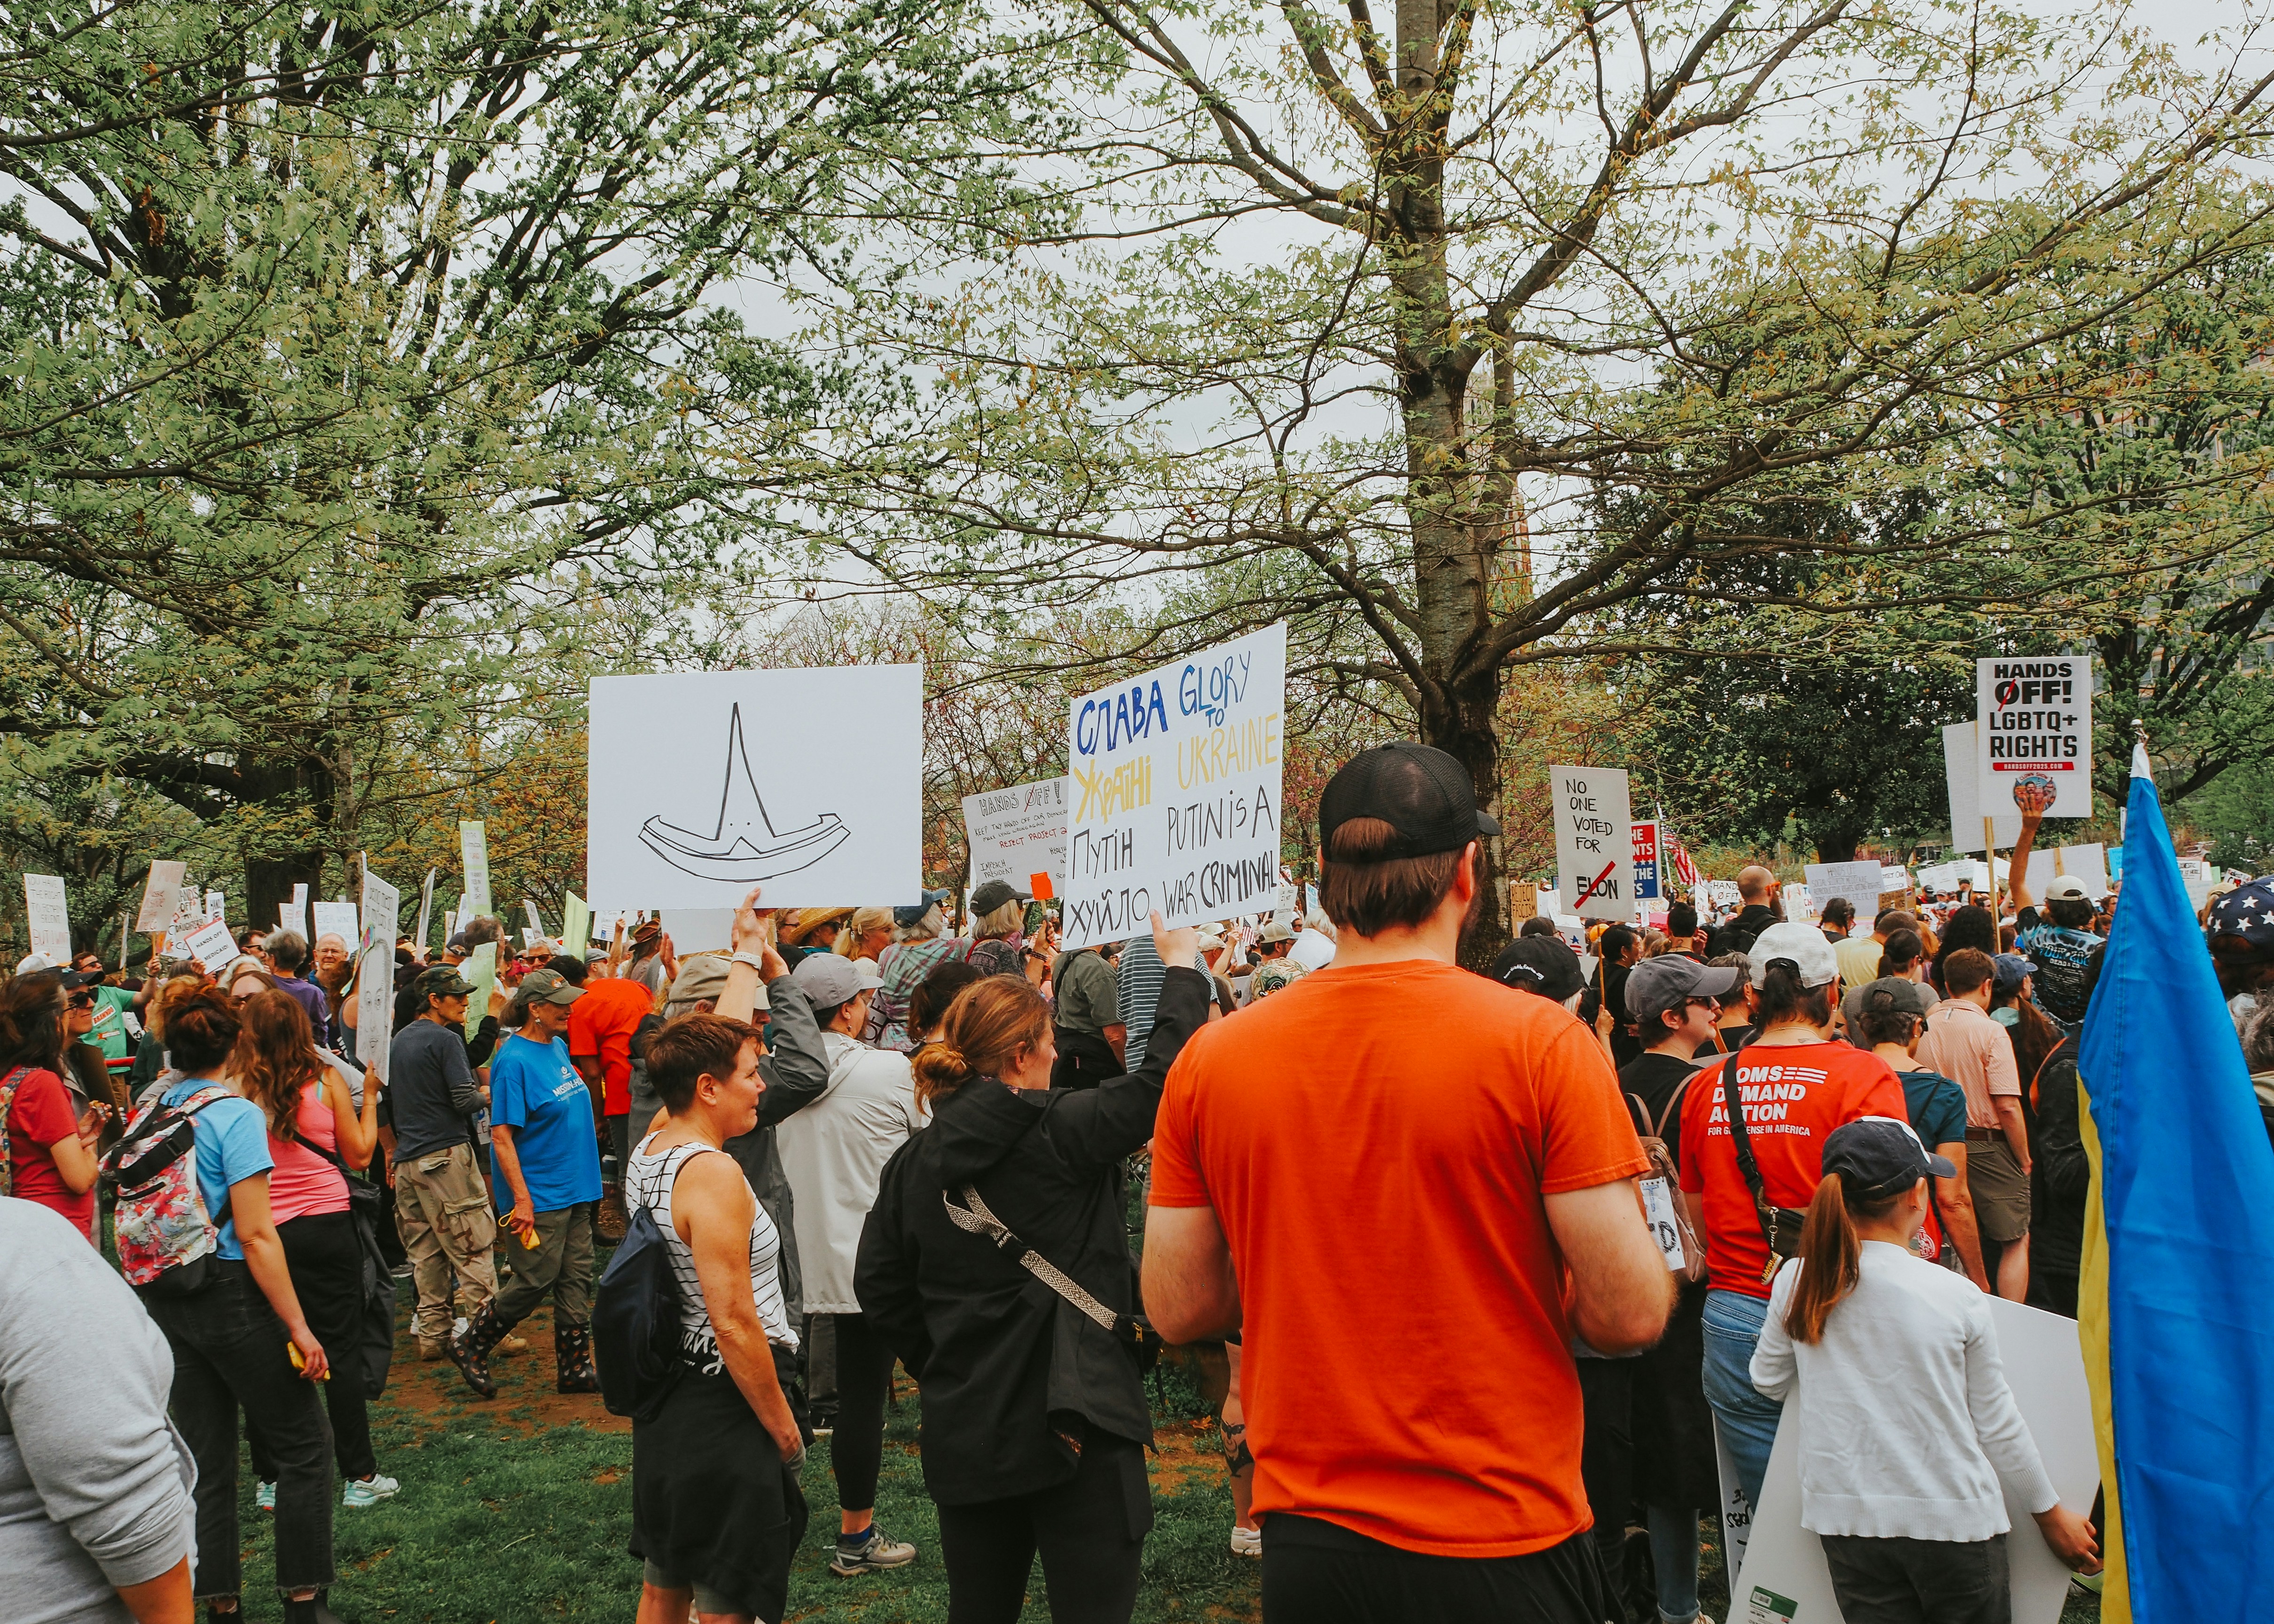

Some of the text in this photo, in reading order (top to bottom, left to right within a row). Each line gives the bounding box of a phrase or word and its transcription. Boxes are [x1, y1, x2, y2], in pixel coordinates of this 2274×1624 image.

[1994, 663, 2072, 678] HANDS
[1180, 650, 1250, 716] GLORY
[1995, 680, 2072, 705] OFF!
[1078, 679, 1168, 756] СЛАВА
[1206, 708, 1224, 728] TO
[1990, 711, 2078, 732] LGBTQ+
[1178, 712, 1278, 790] UKRAINE
[1990, 735, 2077, 757] RIGHTS
[1566, 779, 1587, 794] NO
[979, 792, 1019, 817] HANDS
[1570, 796, 1597, 812] ONE
[1168, 797, 1223, 856] PUTIN
[1252, 785, 1274, 838] A
[1573, 815, 1613, 836] VOTED
[974, 826, 988, 836] KEEP
[999, 837, 1024, 848] REJECT
[1028, 828, 1057, 841] PROJECT
[1576, 836, 1600, 853] FOR
[980, 859, 1006, 872] IMPEACH
[984, 867, 1013, 878] PRESIDENT
[1163, 871, 1197, 919] WAR
[1200, 850, 1277, 907] CRIMINAL
[1511, 884, 1533, 902] REJECT
[1576, 876, 1618, 899] ELON
[1717, 892, 1738, 900] OFF!
[1512, 903, 1537, 918] FASCISM
[196, 930, 223, 948] HANDS OFF
[1708, 1126, 1722, 1136] FOR
[1747, 1125, 1764, 1134] ENSE
[1765, 1124, 1773, 1133] IN
[1774, 1124, 1811, 1136] AMERICA
